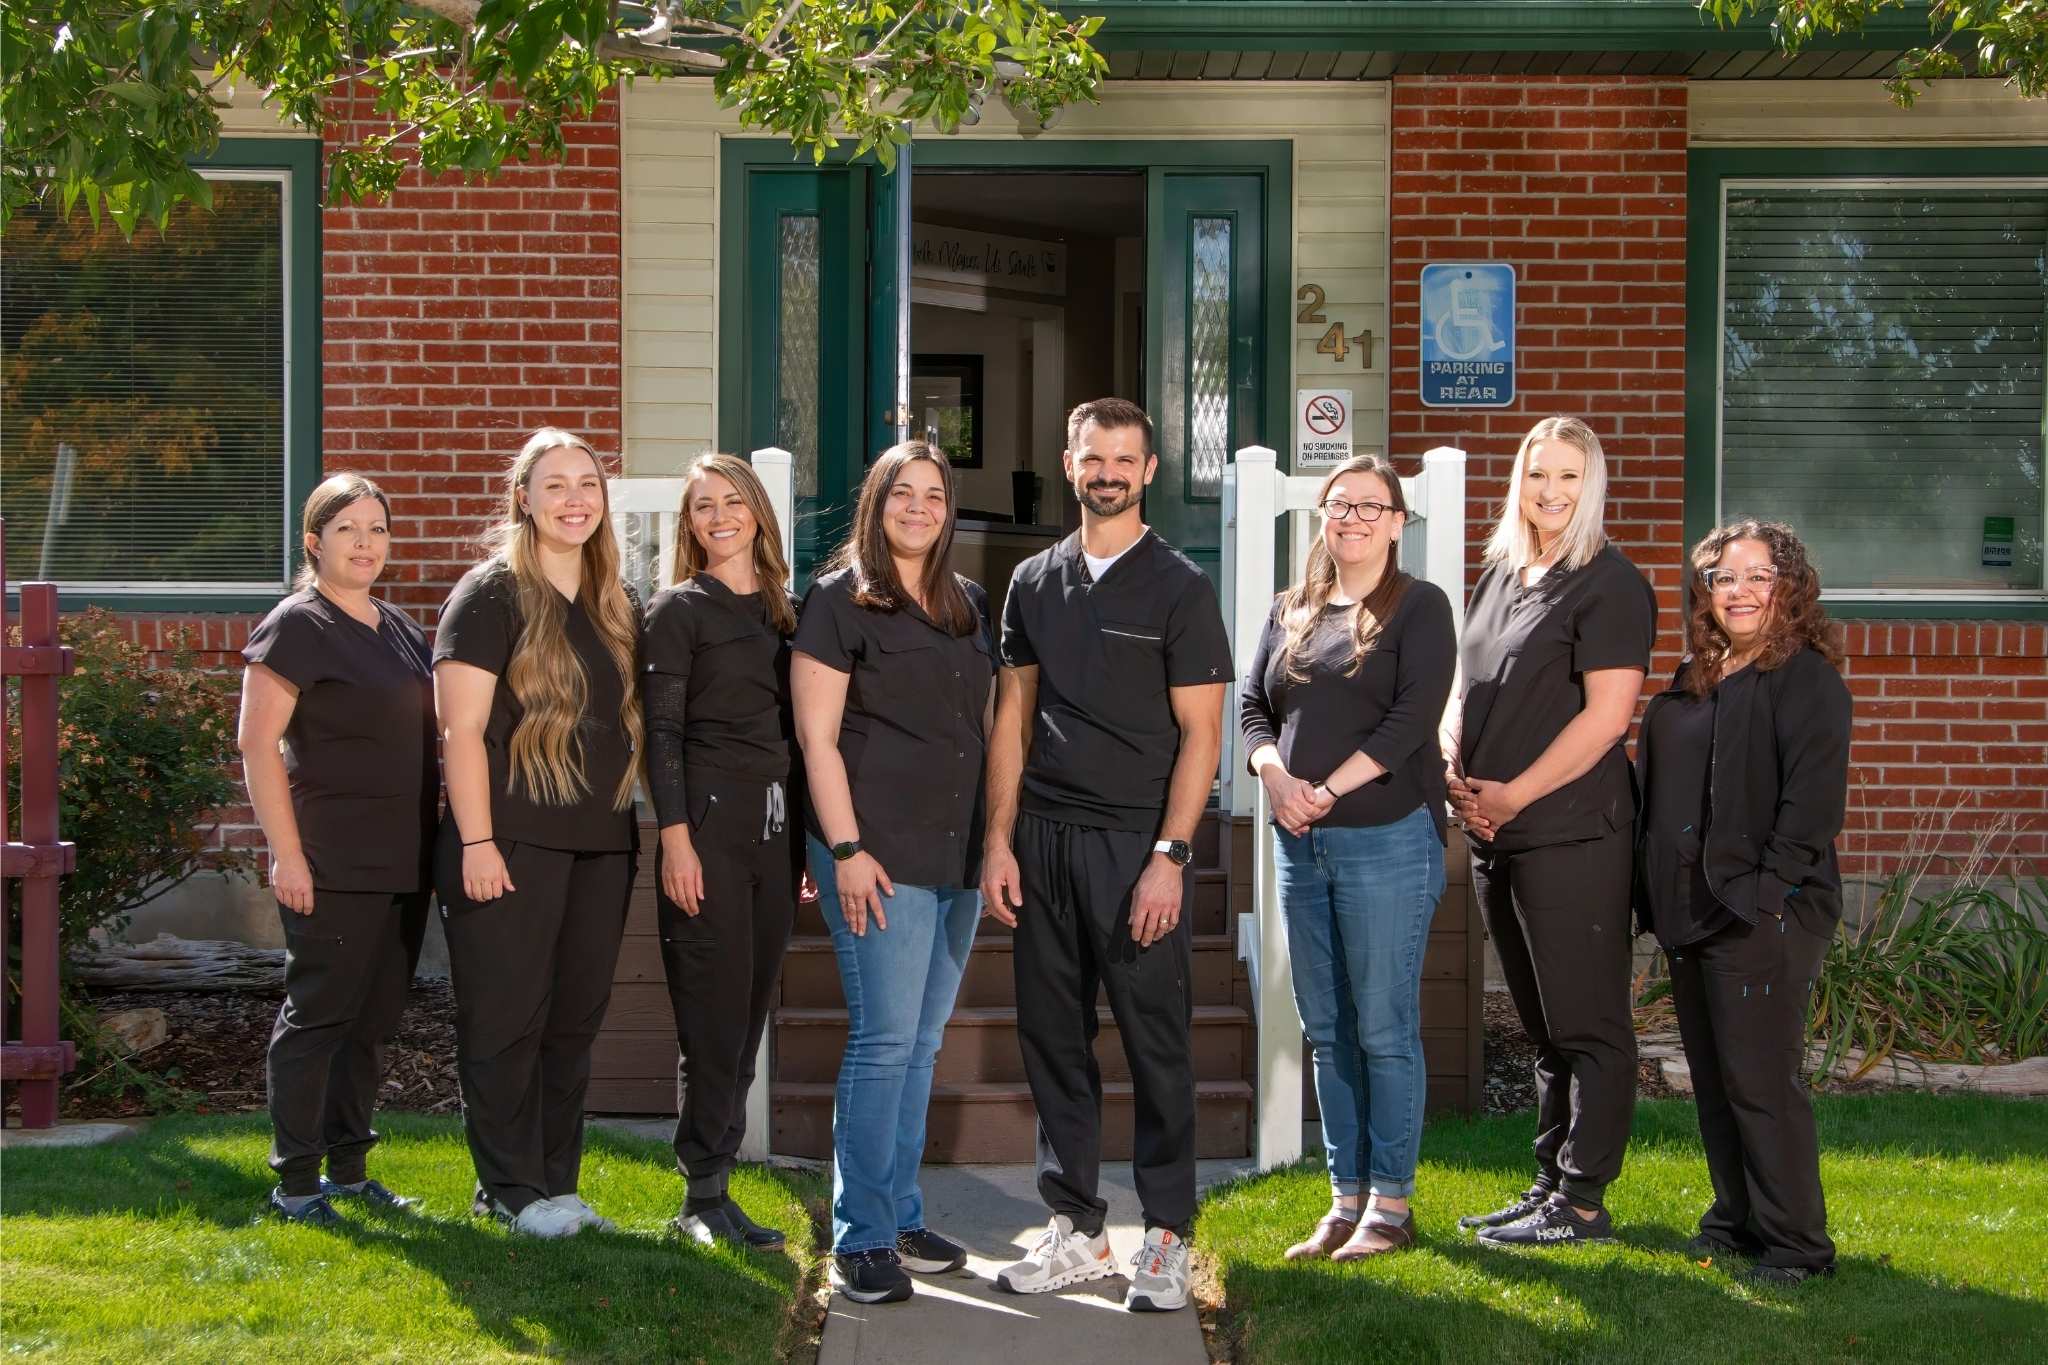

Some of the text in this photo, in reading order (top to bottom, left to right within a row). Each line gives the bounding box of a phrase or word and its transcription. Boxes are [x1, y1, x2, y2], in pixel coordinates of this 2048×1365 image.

[1431, 362, 1505, 374] PARKING
[1456, 375, 1478, 385] AT
[1440, 386, 1497, 400] REAR
[1303, 442, 1348, 451] NO SMOKING
[1302, 452, 1349, 461] ON PREMISES
[1535, 1225, 1575, 1241] HOKA
